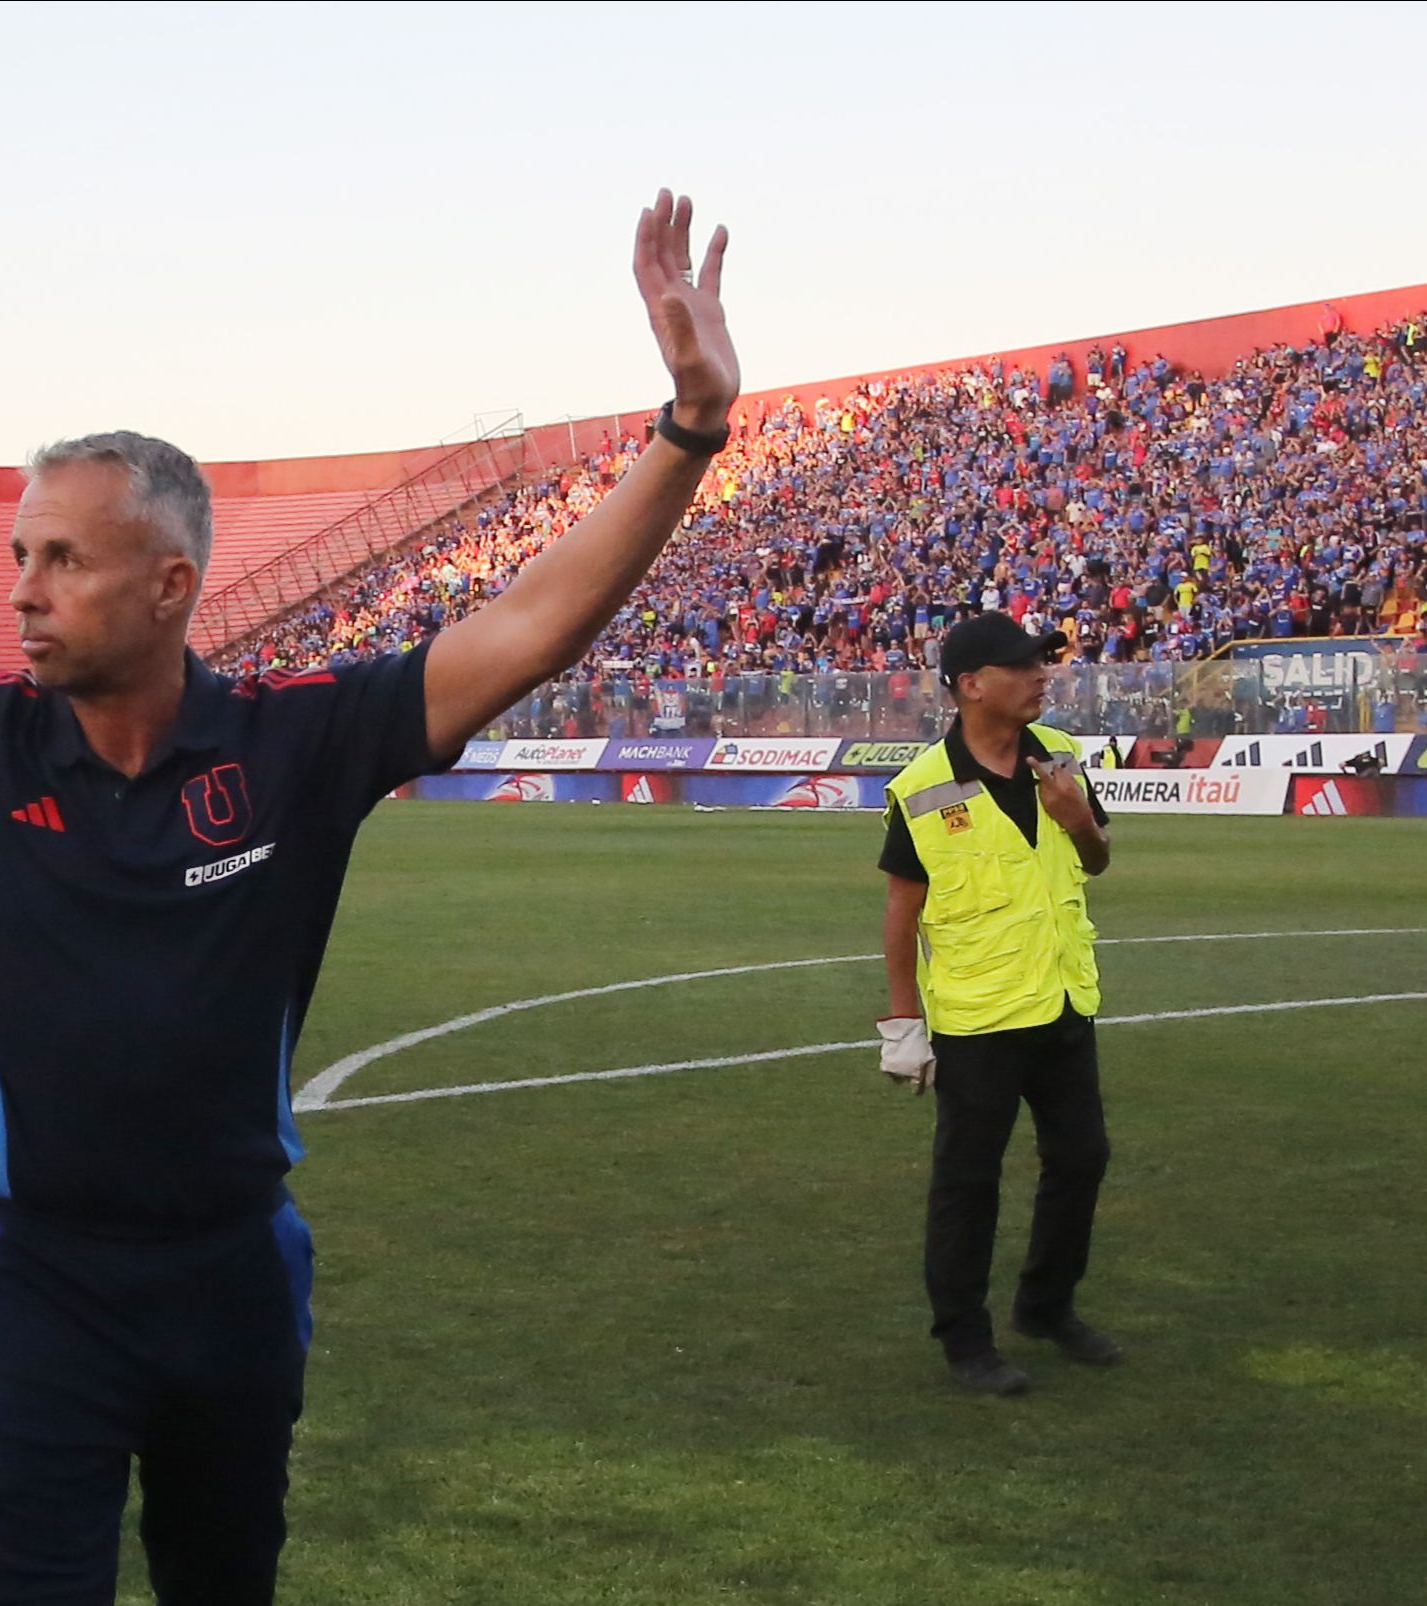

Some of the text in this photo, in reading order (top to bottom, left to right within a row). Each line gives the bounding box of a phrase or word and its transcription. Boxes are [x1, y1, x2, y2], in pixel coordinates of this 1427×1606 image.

[1263, 652, 1373, 687] SALID
[618, 746, 692, 759] MACHBANK
[739, 749, 828, 766] SODIMAC
[1094, 775, 1241, 804] PRIMERA itaú
[205, 856, 247, 880] JUGA
